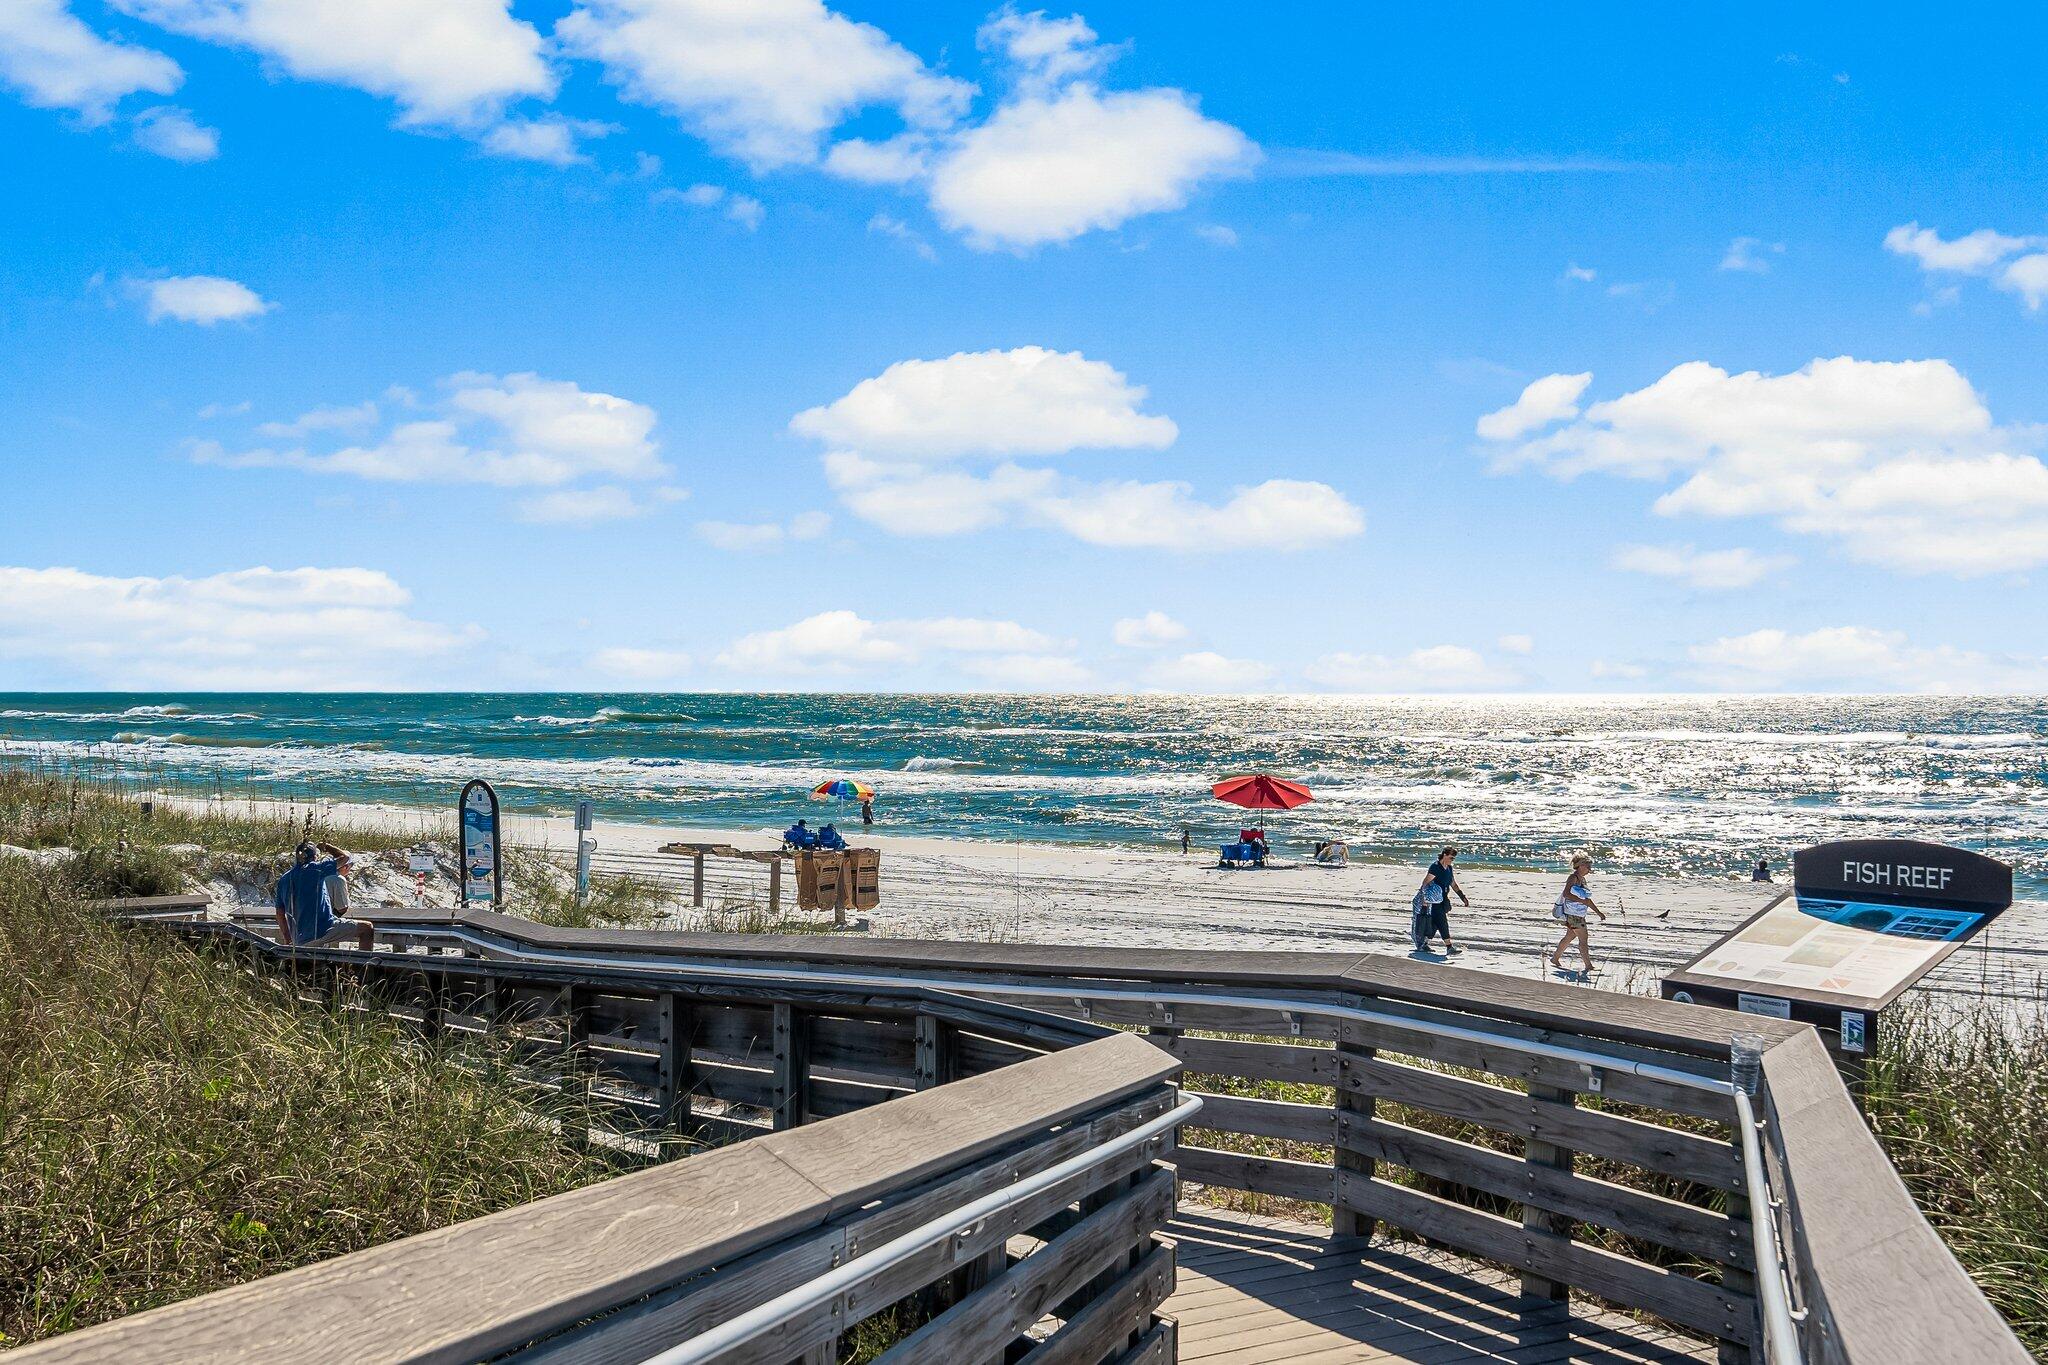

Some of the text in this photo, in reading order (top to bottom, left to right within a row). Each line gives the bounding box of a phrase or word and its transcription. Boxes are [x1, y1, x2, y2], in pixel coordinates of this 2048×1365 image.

[1843, 861, 1954, 890] FISH REEF
[1759, 999, 1781, 1007] PROVIDED
